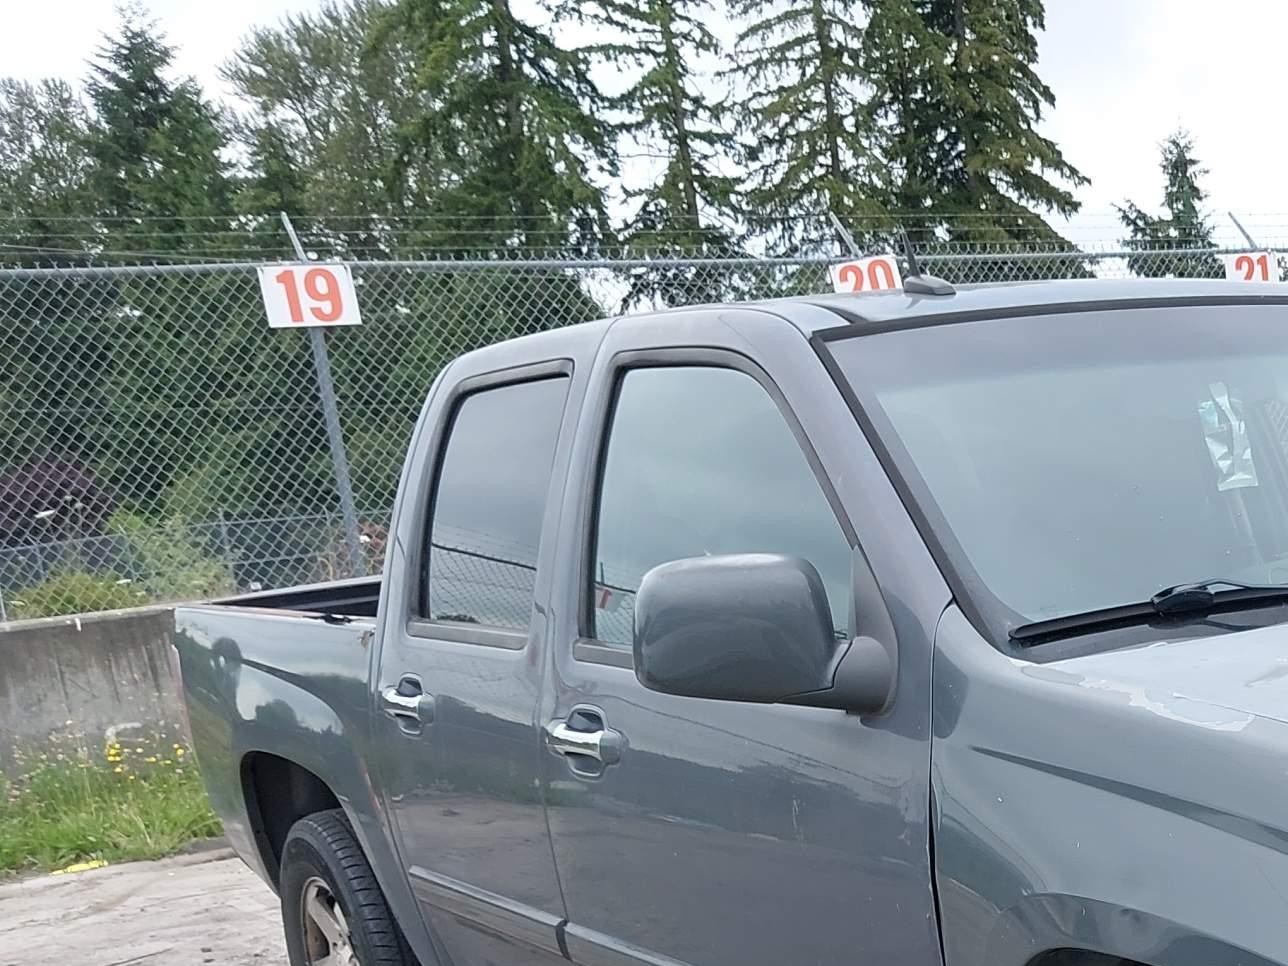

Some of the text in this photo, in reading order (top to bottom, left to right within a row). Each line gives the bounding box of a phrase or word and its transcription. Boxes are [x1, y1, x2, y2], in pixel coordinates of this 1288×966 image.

[839, 259, 896, 292] 20
[1235, 255, 1269, 281] 21
[276, 268, 343, 322] 19
